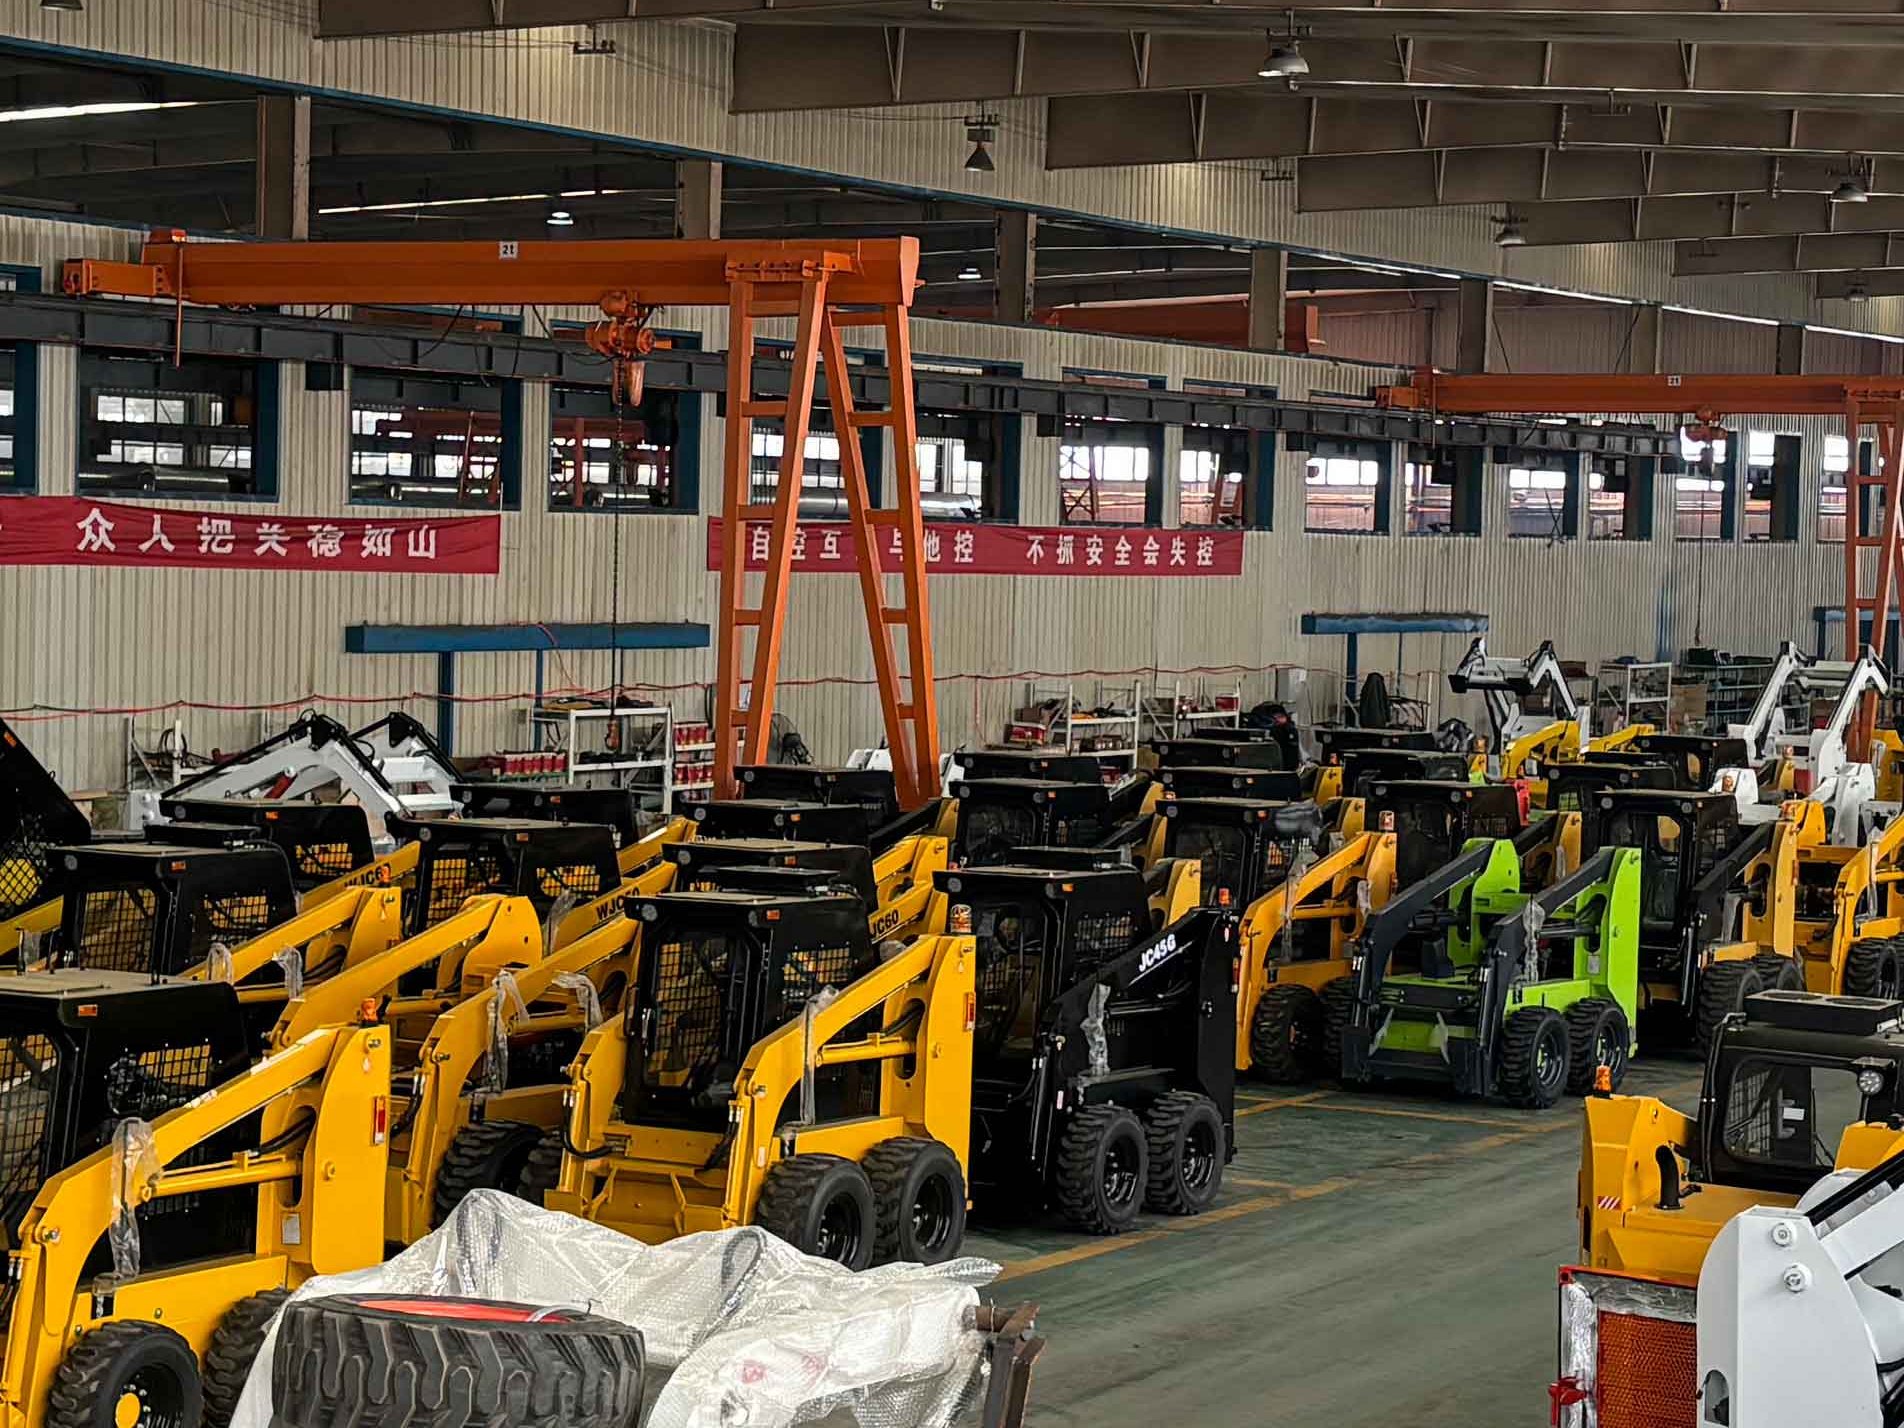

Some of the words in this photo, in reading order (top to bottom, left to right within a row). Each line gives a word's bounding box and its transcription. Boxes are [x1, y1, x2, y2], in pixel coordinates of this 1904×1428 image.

[76, 507, 438, 559] 众人把关稳如山
[1026, 533, 1215, 566] 不抓安全会失控
